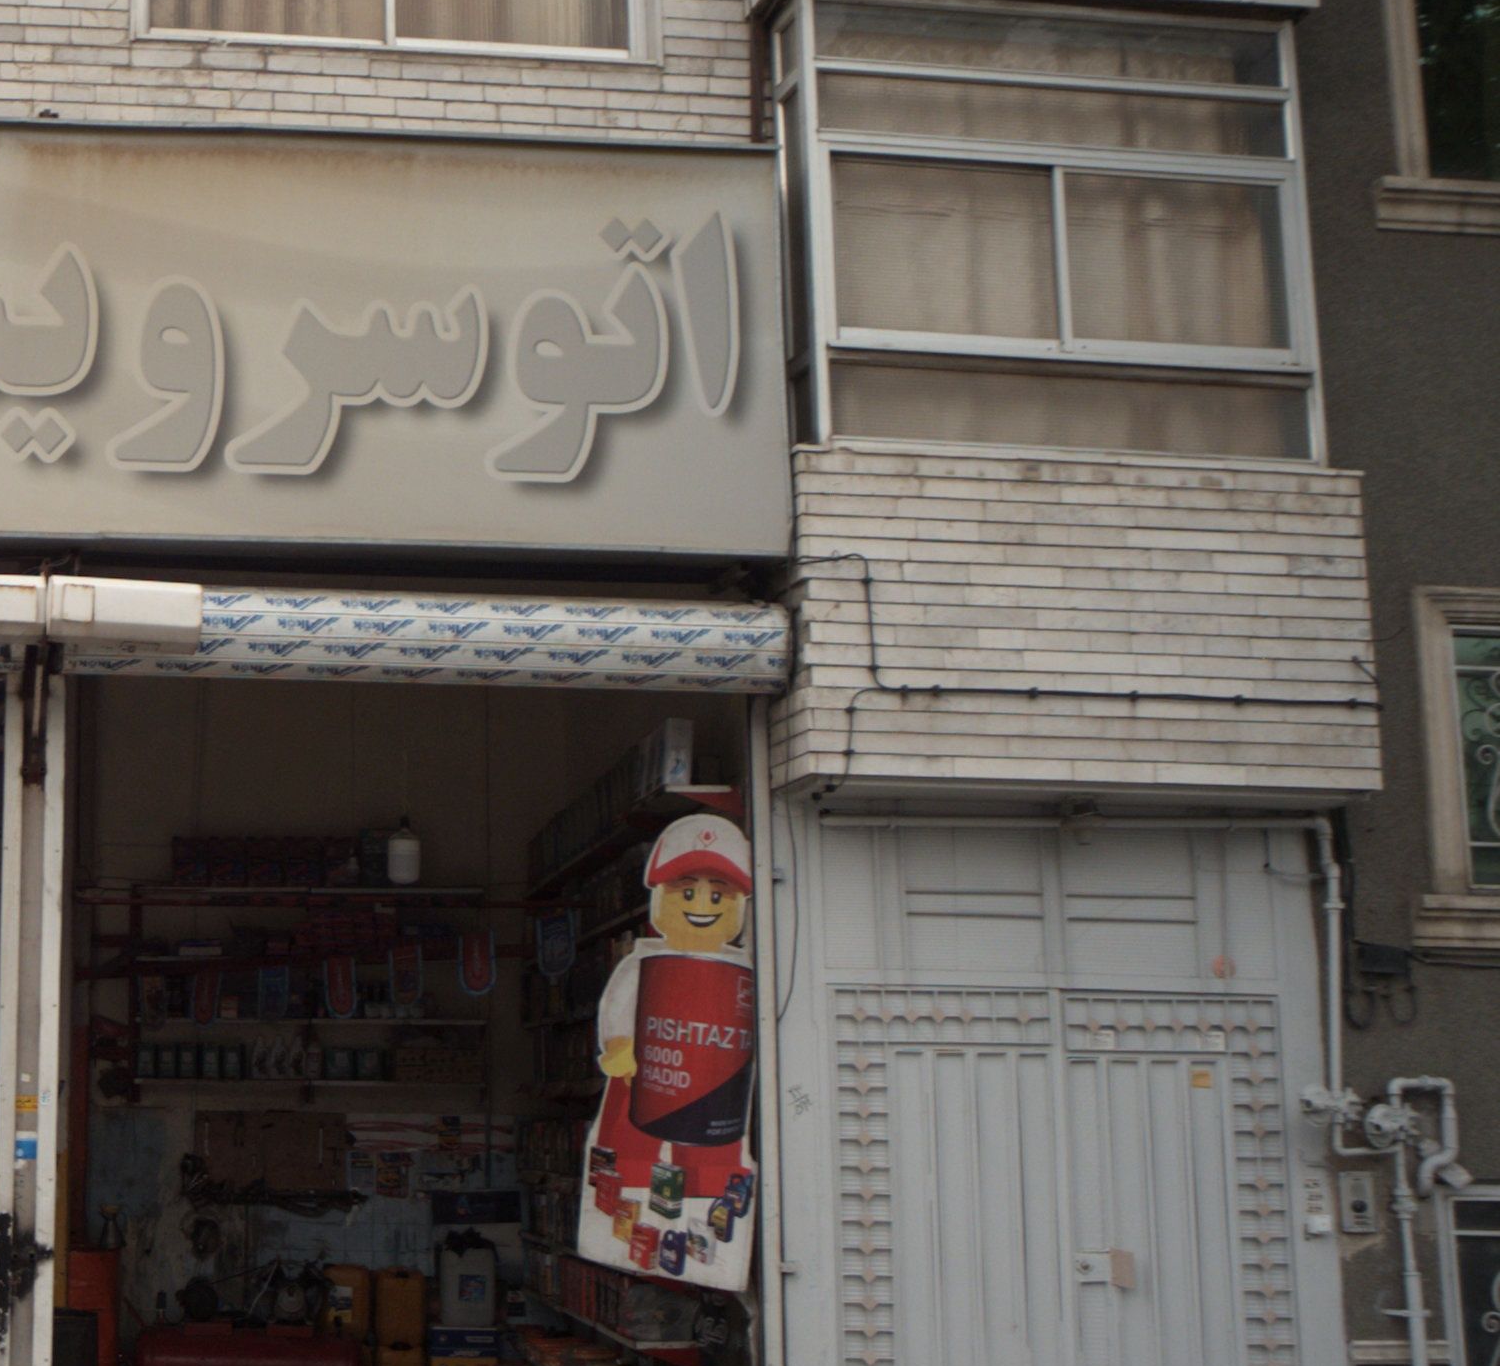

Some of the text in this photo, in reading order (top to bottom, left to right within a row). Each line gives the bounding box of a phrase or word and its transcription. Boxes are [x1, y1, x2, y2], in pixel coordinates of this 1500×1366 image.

[645, 1016, 734, 1050] PISHTAZ
[643, 1045, 683, 1067] 6000
[641, 1064, 691, 1089] HADID
